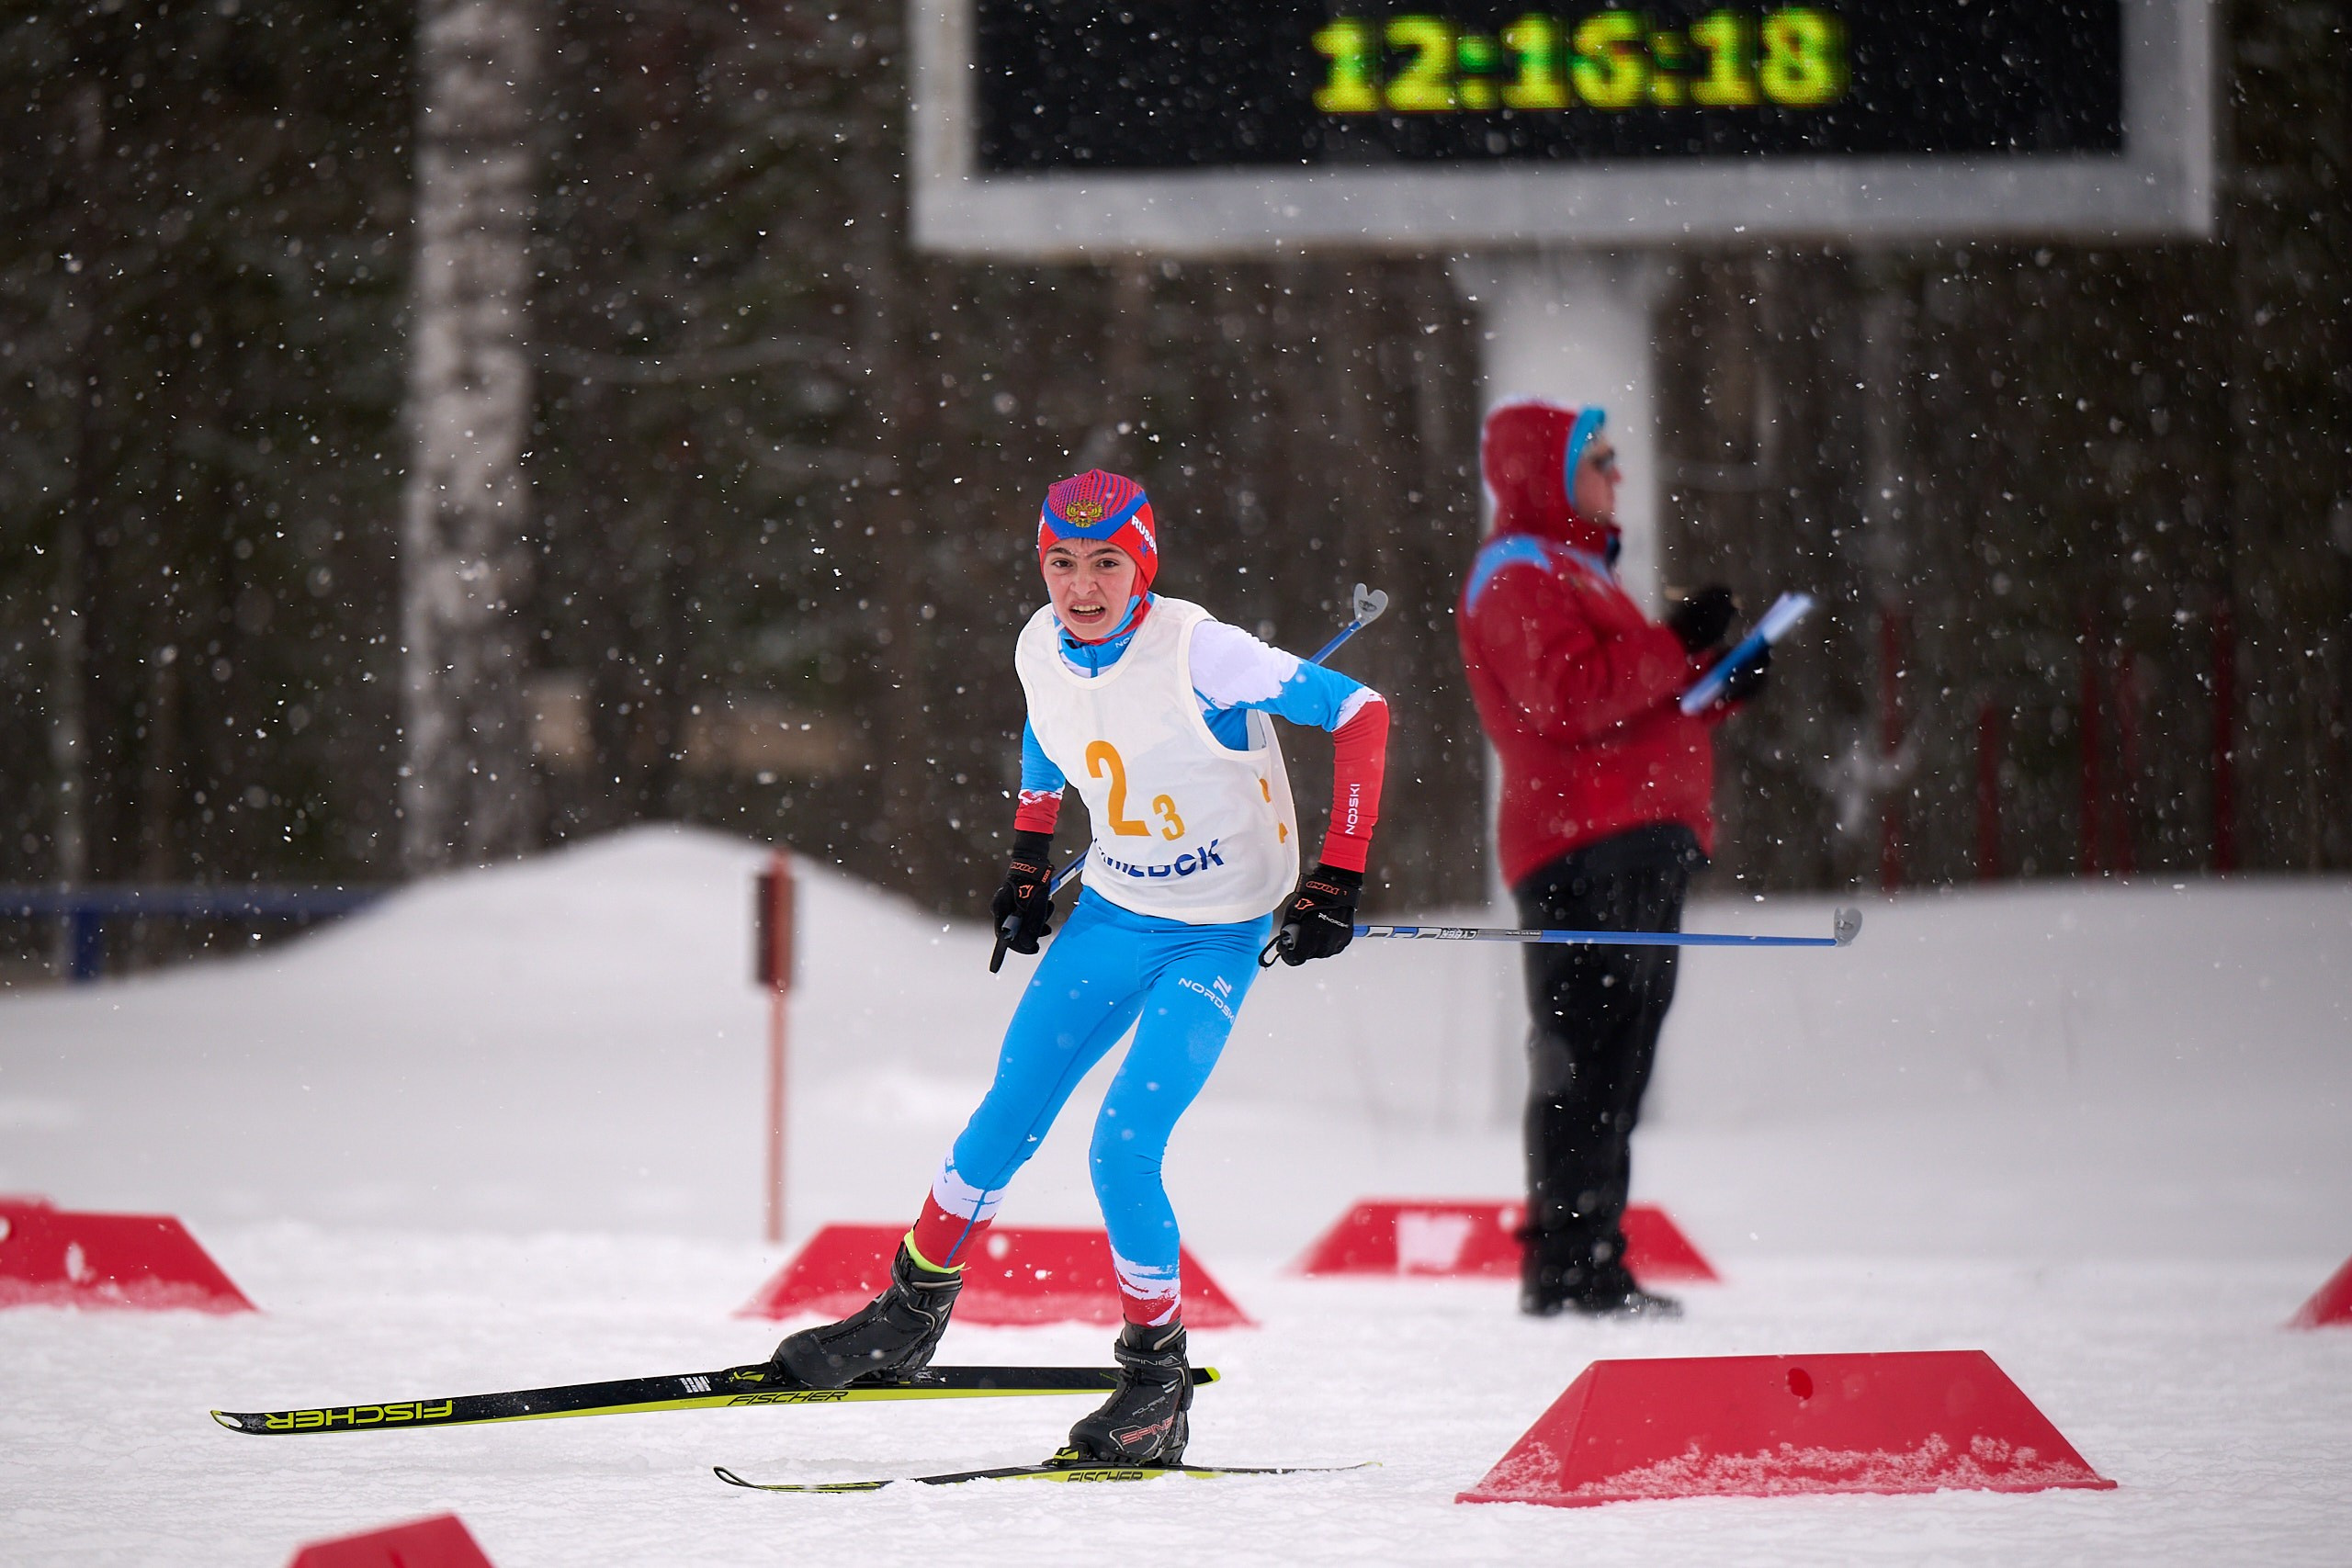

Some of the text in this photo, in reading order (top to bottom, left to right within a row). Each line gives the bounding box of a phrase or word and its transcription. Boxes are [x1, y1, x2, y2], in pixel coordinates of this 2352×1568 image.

[1086, 740, 1152, 837] 2
[1152, 794, 1185, 841] 3
[727, 1391, 849, 1405] FISCHER
[265, 1400, 453, 1429] FISCHER
[1120, 1415, 1174, 1446] SPINE
[1068, 1472, 1144, 1483] FISCHER
